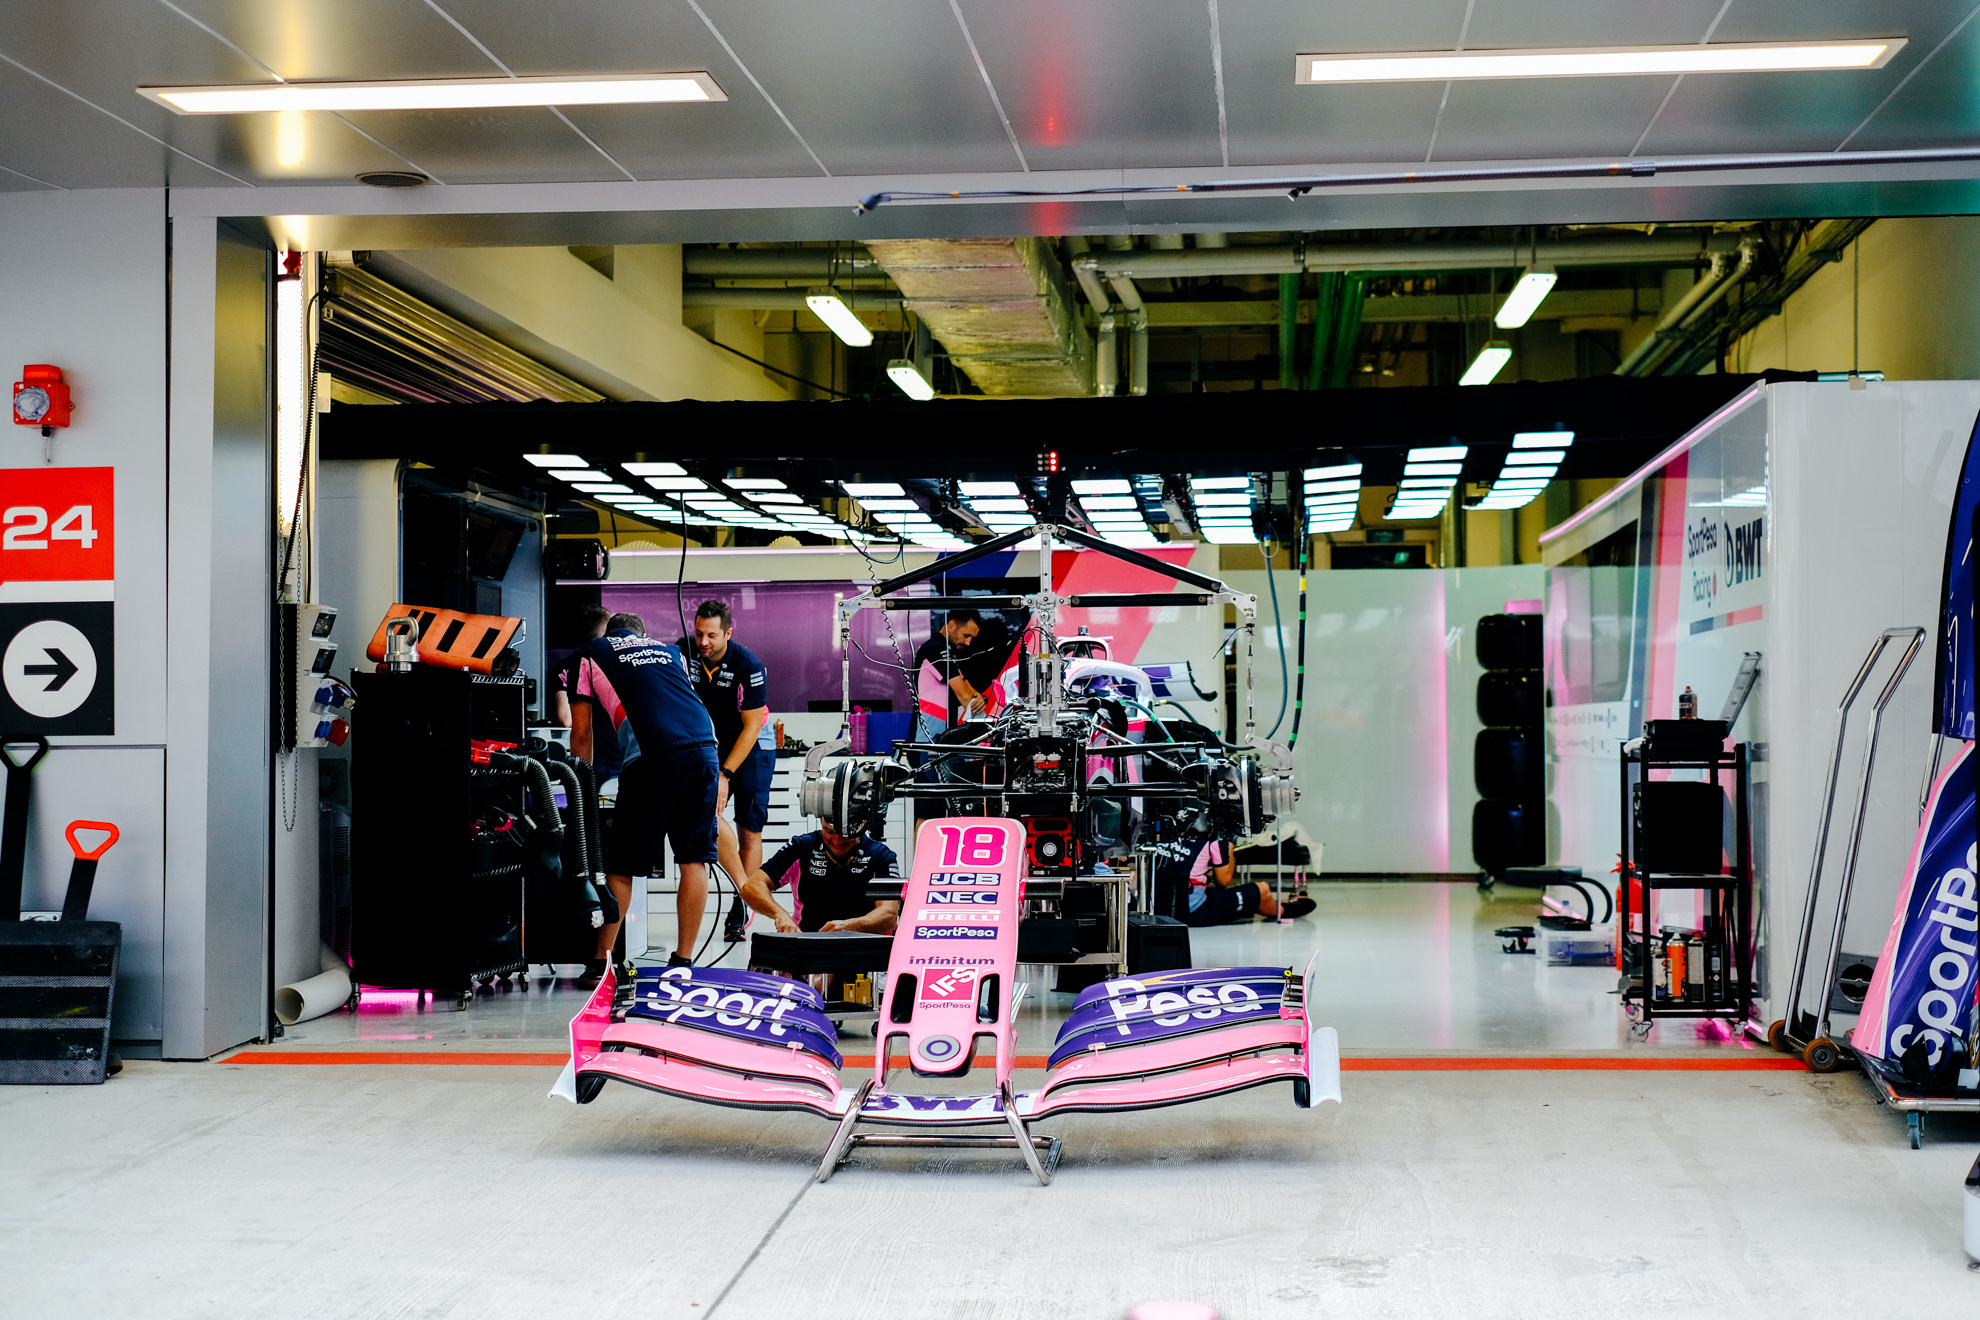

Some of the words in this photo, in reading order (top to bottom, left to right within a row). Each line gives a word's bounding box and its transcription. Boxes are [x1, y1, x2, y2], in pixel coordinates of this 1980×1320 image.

[3, 505, 98, 550] 24
[1688, 517, 1718, 568] SportPesa
[1736, 517, 1763, 585] BWT
[1693, 570, 1712, 609] Racing
[618, 648, 672, 663] SportPesa
[631, 657, 668, 667] Racing
[936, 825, 1009, 868] 18
[810, 859, 828, 868] NEC
[930, 873, 1000, 886] JCB
[927, 892, 998, 904] NEC
[917, 909, 1002, 921] PIRELLI
[917, 927, 995, 939] SportPesa
[909, 956, 995, 965] infinitum
[928, 968, 977, 997] IFS
[647, 967, 798, 1037] Sport
[919, 1002, 971, 1010] SportPesa
[1105, 979, 1263, 1035] Pesa
